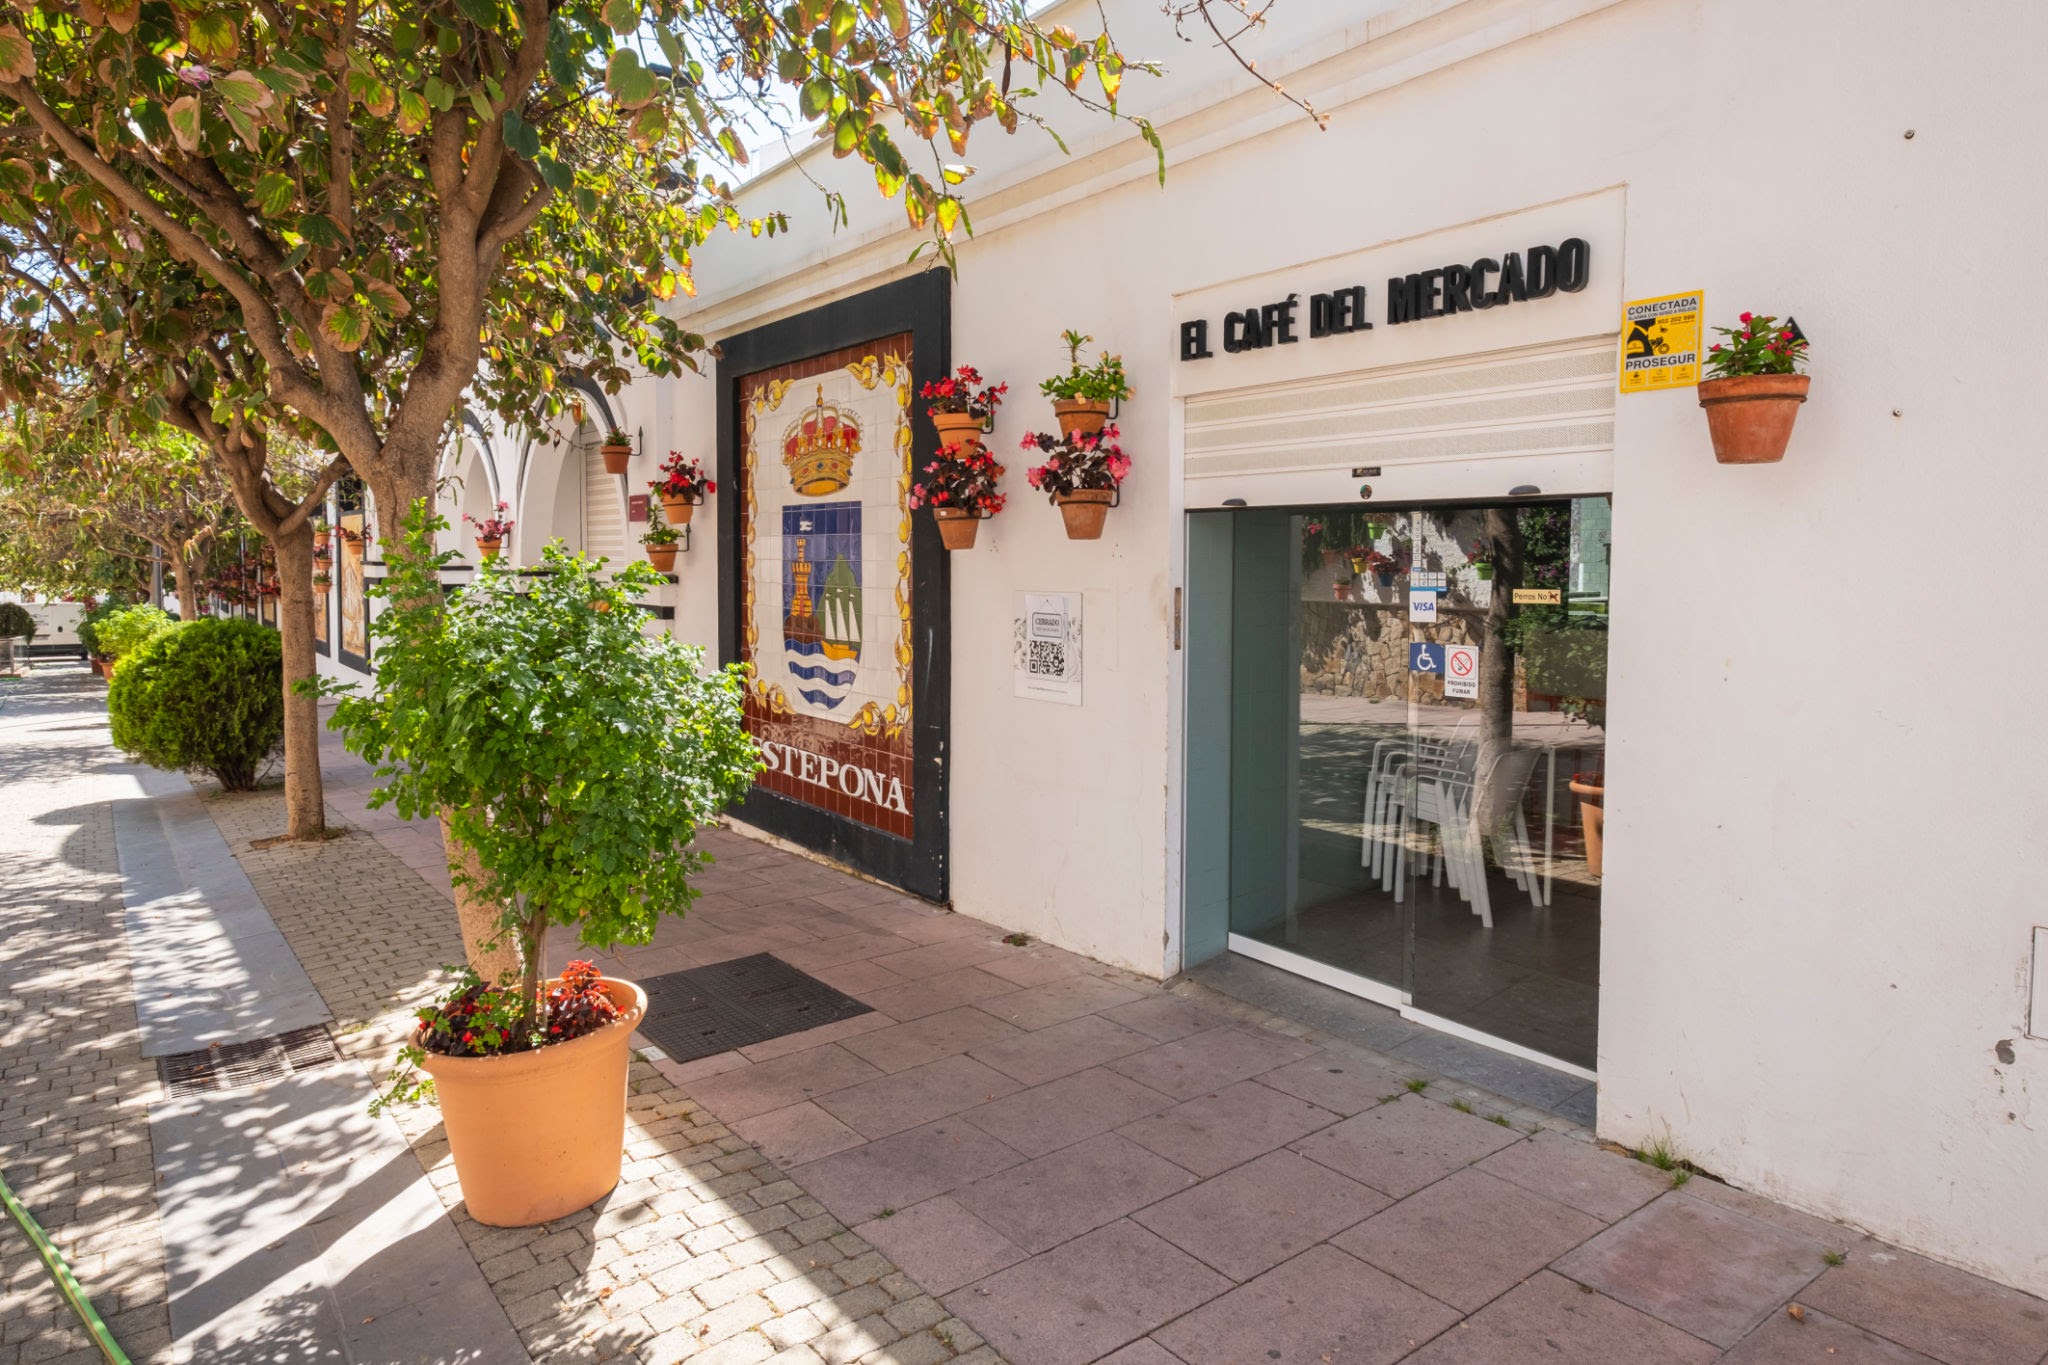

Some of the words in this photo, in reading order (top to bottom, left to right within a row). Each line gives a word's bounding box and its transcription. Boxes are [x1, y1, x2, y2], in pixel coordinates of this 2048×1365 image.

[1181, 319, 1213, 361] EL
[1224, 293, 1299, 353] CAFÉ
[1310, 285, 1373, 339] DEL
[1387, 237, 1591, 325] MERCADO
[1627, 297, 1697, 315] CONECTADA
[1625, 353, 1696, 370] PROSEGUR
[1514, 592, 1536, 601] Perros
[1537, 592, 1547, 600] No
[1413, 602, 1435, 612] VISA
[1447, 680, 1476, 688] PROHIBIDO
